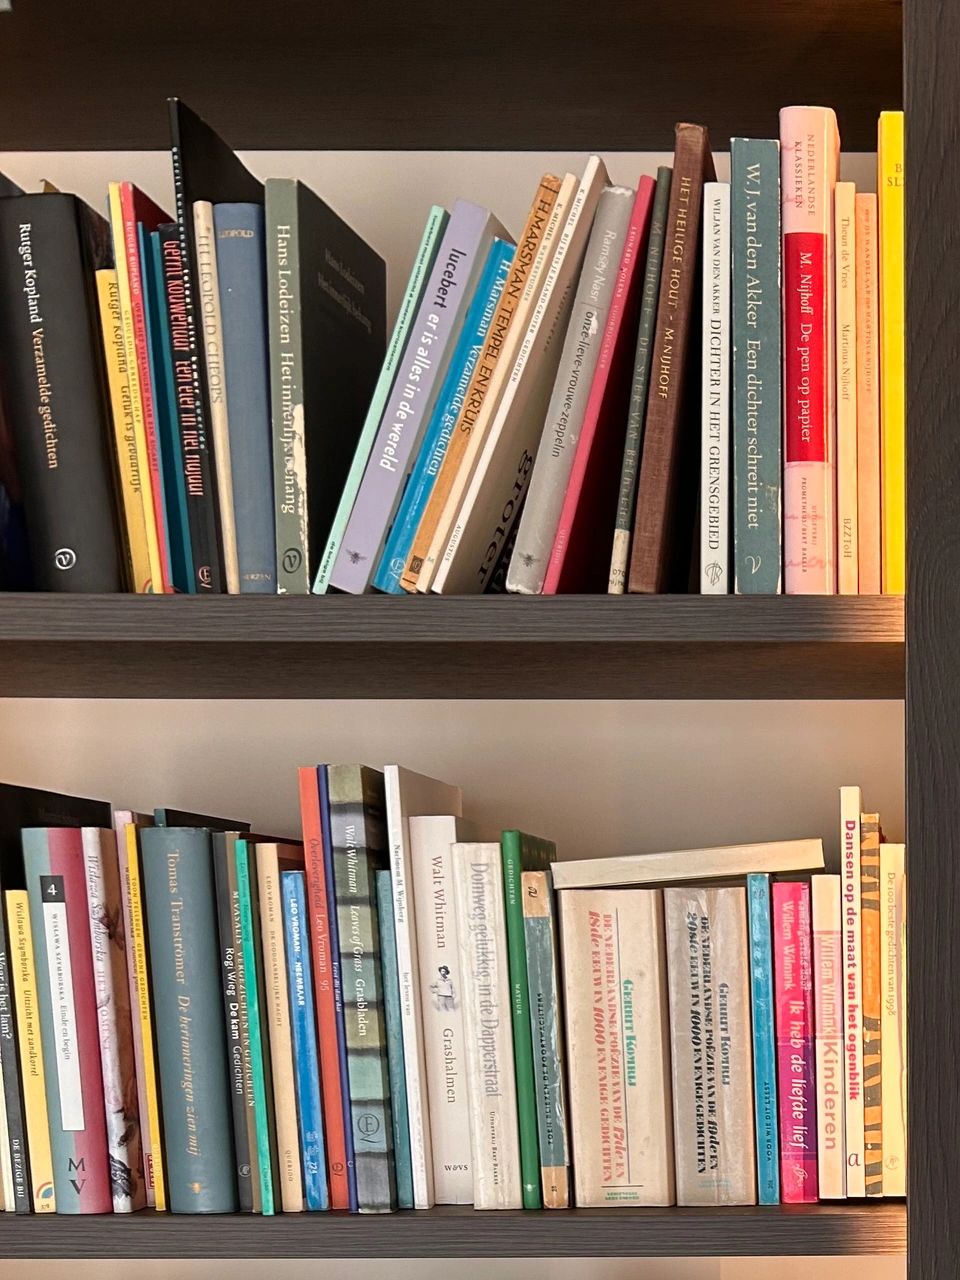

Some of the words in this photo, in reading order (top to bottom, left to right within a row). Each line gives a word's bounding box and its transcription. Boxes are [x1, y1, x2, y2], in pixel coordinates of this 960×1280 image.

[805, 132, 816, 216] NEDERLANDSE
[17, 222, 33, 268] Rutger
[22, 267, 44, 324] Kopland
[431, 246, 468, 309] lucebert
[419, 329, 439, 346] is
[424, 312, 440, 331] er
[30, 326, 53, 404] Verzamelde
[406, 345, 432, 383] alles
[394, 399, 415, 421] de
[401, 382, 421, 400] in
[36, 404, 59, 470] gedichten
[377, 421, 405, 473] wereld
[430, 854, 446, 886] Walt
[843, 818, 857, 880] Dansen
[842, 882, 855, 904] op
[432, 887, 448, 949] Whitman
[844, 905, 858, 927] de
[845, 928, 858, 969] maat
[845, 971, 856, 1001] van
[846, 1002, 860, 1030] het
[441, 1026, 459, 1104] Grashalmen
[843, 1031, 861, 1101] ogenblik
